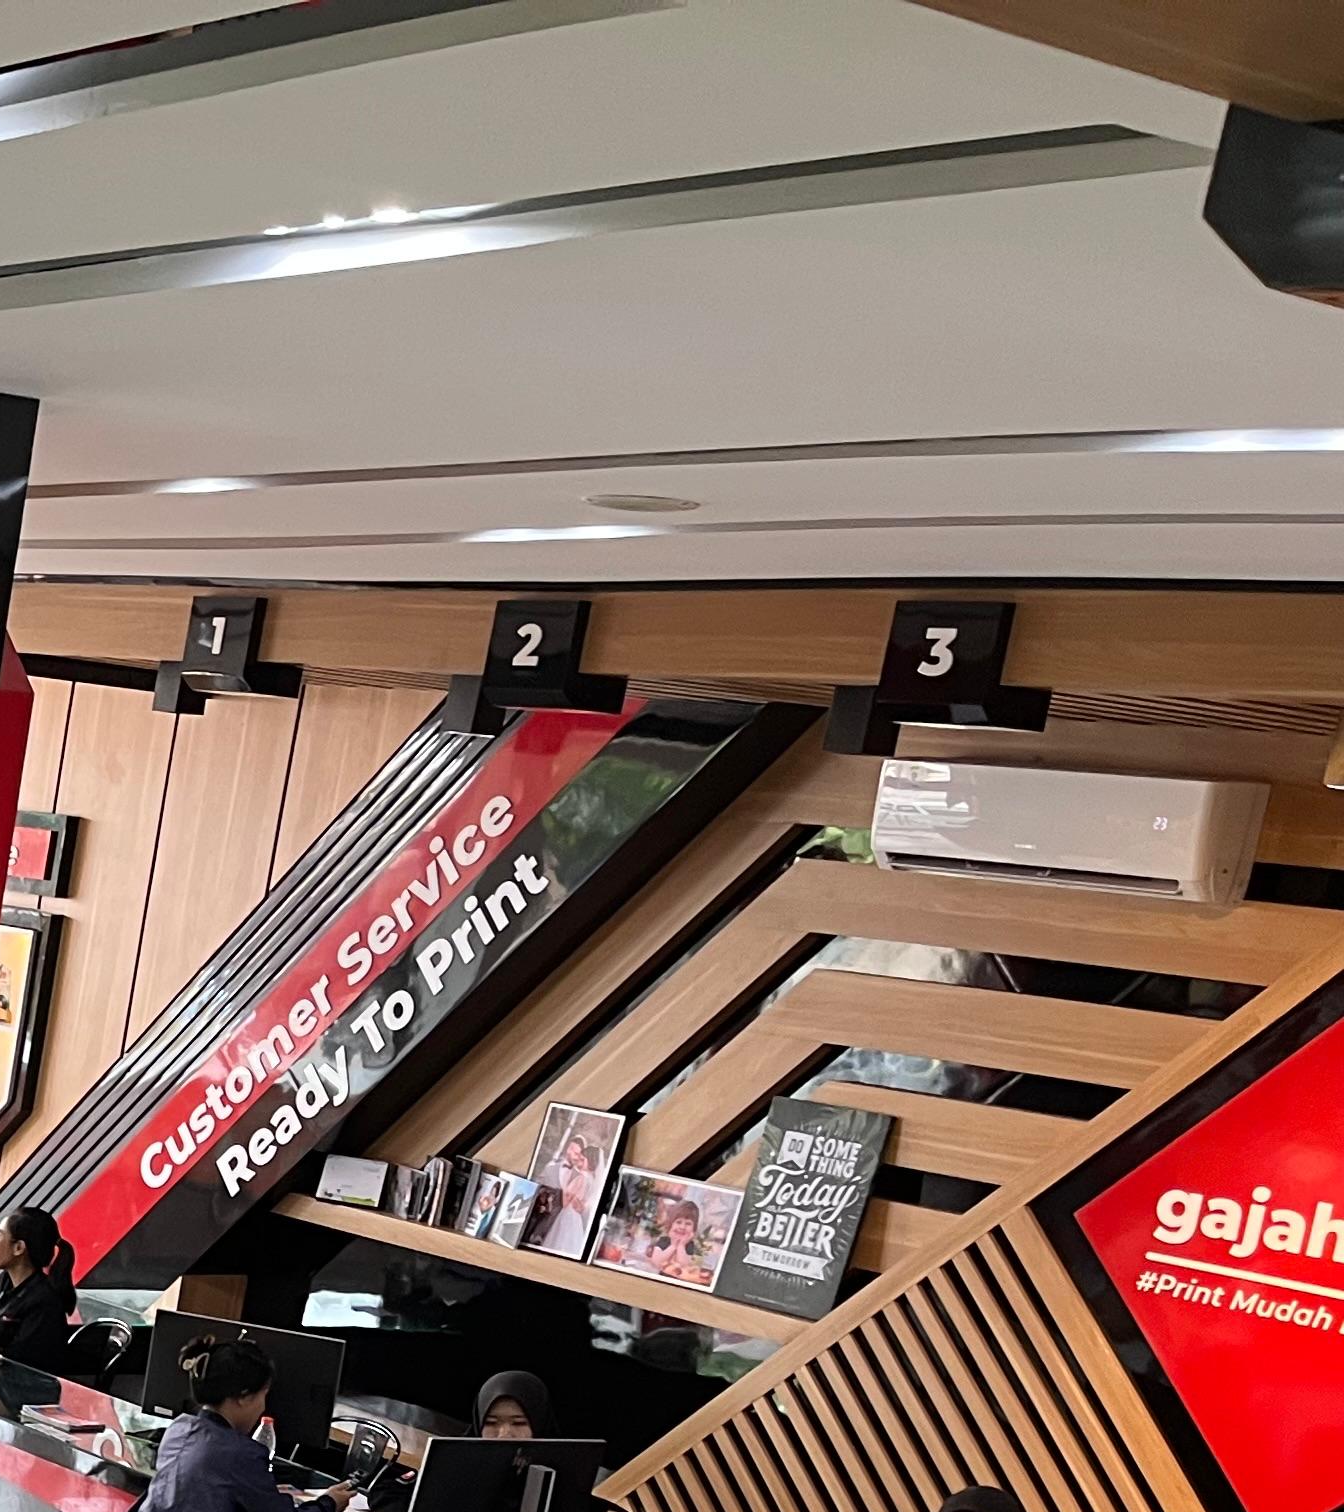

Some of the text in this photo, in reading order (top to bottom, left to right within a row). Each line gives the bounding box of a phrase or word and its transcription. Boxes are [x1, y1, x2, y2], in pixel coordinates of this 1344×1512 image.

[212, 616, 227, 655] 1
[511, 623, 543, 667] 2
[916, 627, 958, 677] 3
[1152, 816, 1168, 831] 23
[138, 794, 515, 1190] Customer Service
[214, 853, 551, 1198] Ready To Print
[808, 1154, 855, 1179] THING
[811, 1136, 863, 1162] SOME
[754, 1163, 863, 1224] Today
[754, 1208, 835, 1261] BETTER
[1135, 1270, 1226, 1308] #Print
[1229, 1289, 1334, 1332] Mudah
